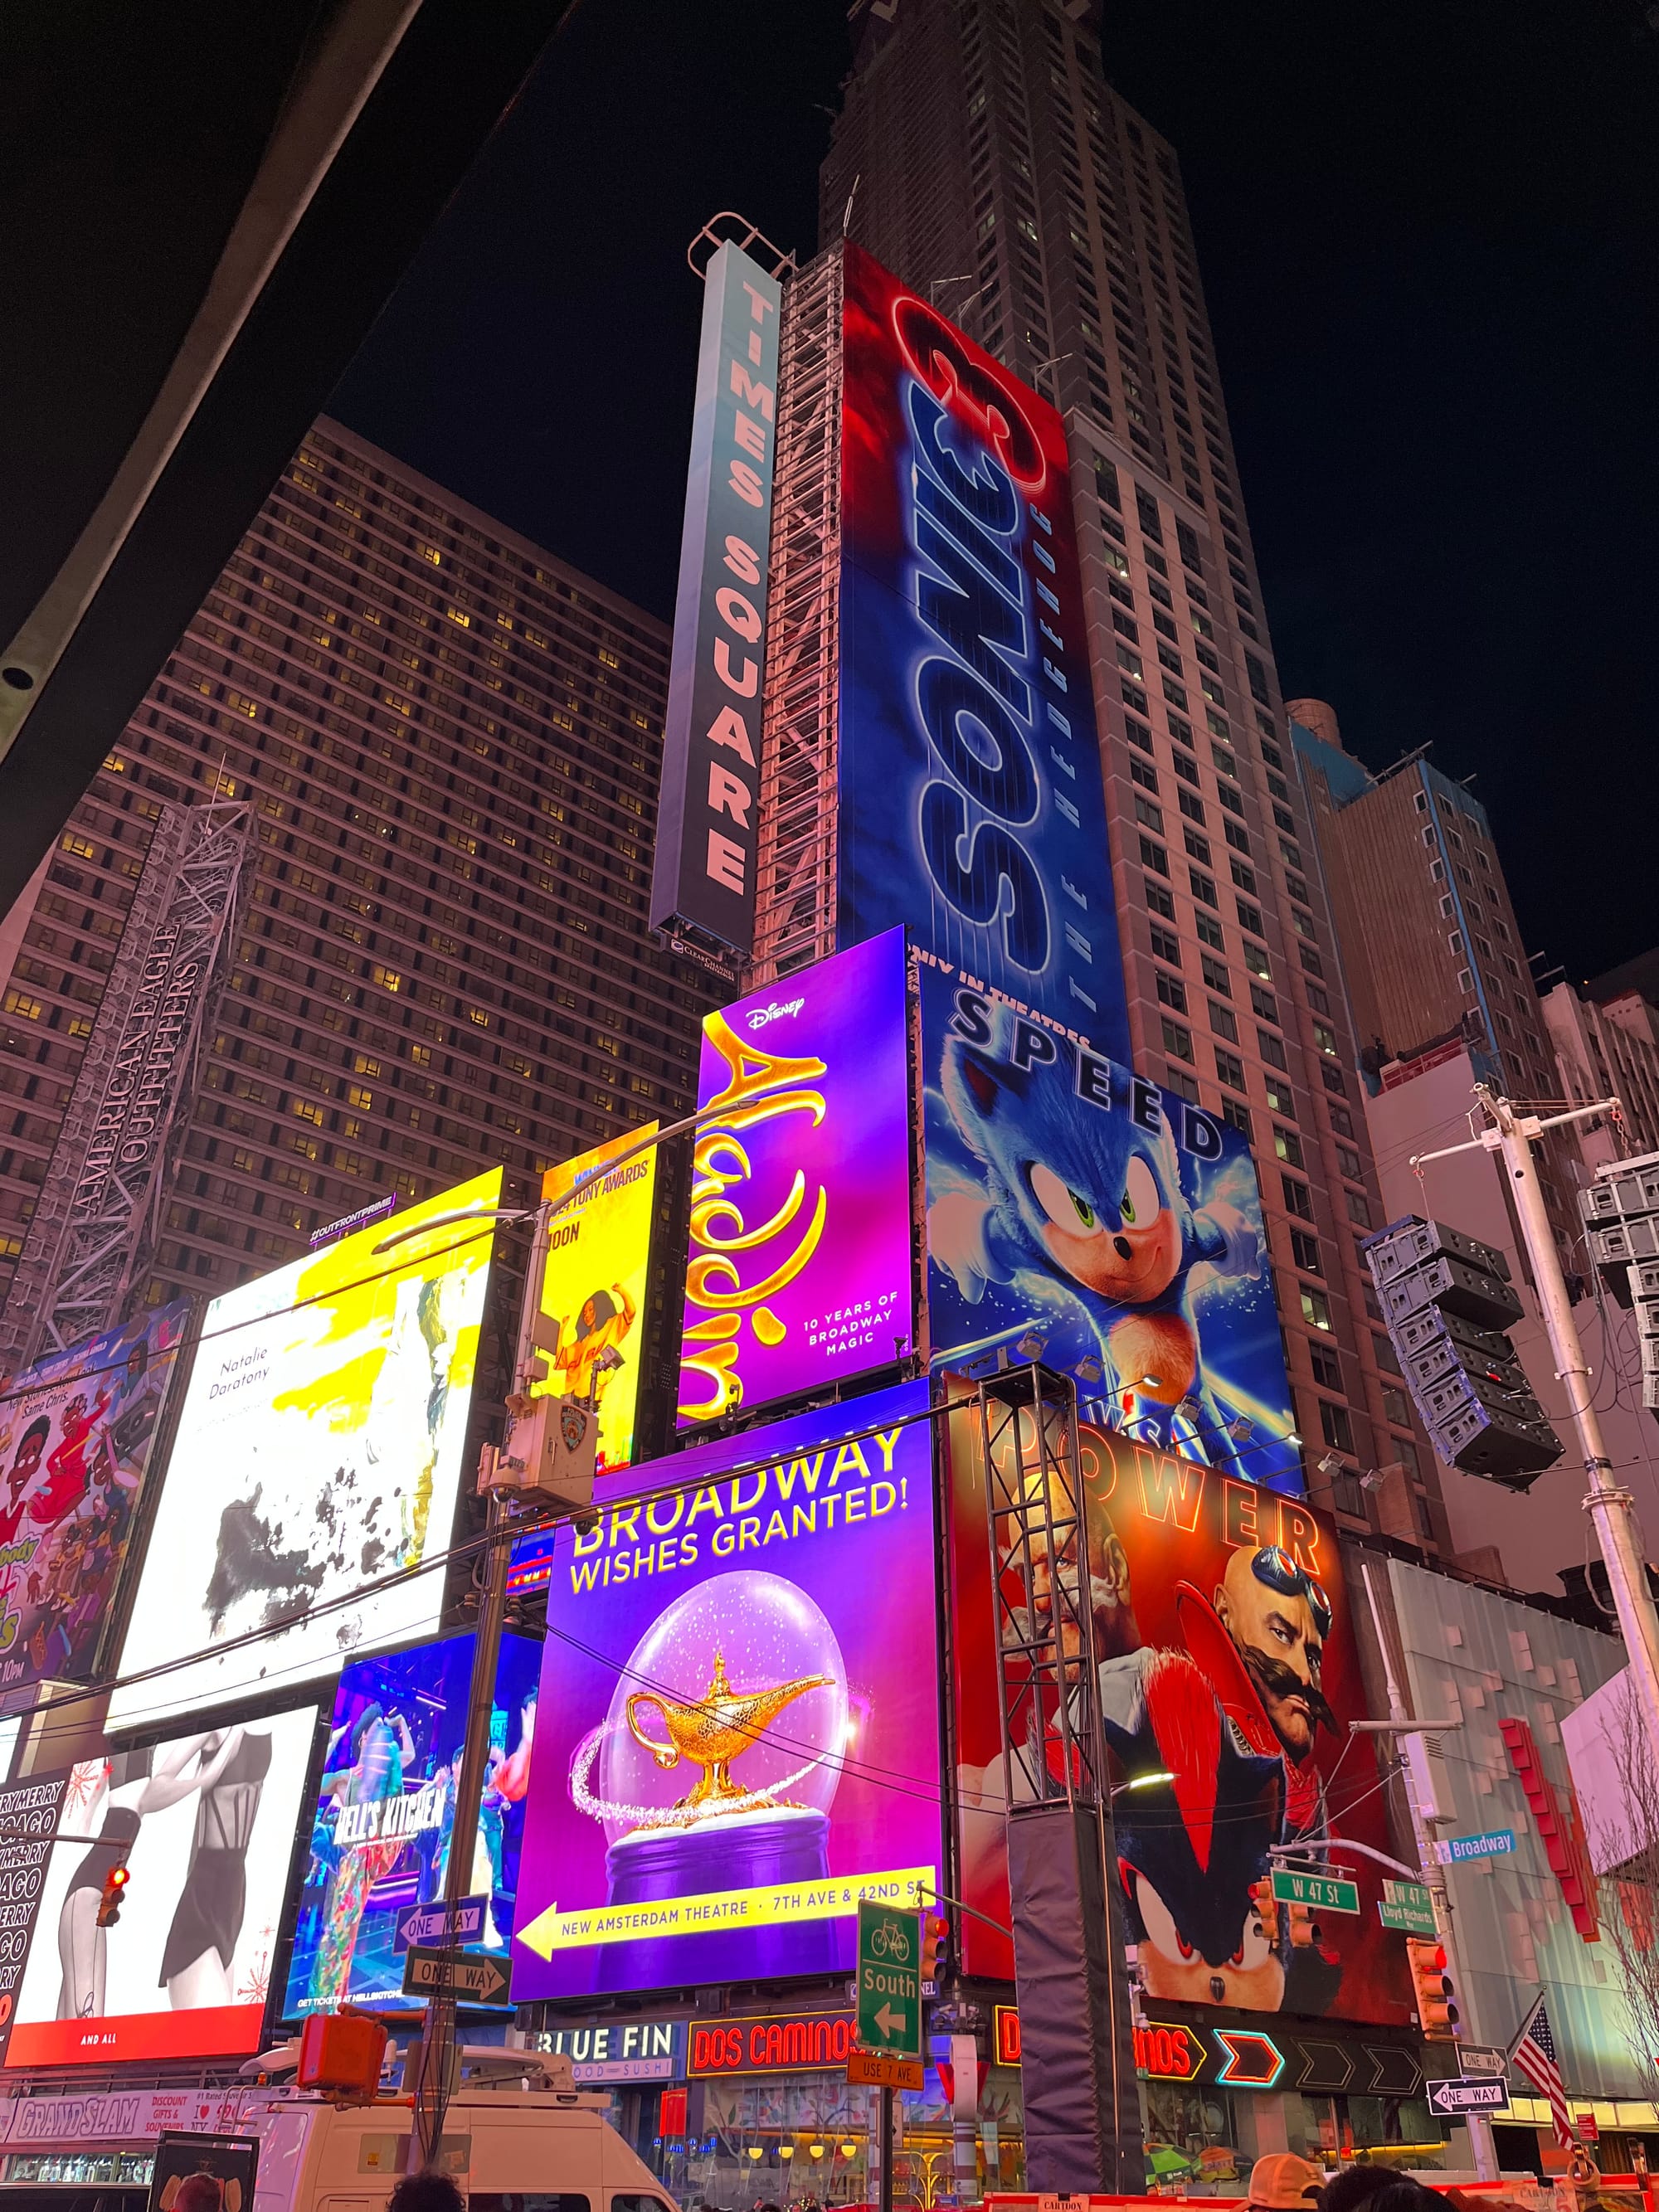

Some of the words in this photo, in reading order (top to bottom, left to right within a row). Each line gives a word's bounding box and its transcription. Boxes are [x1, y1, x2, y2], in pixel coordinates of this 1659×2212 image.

[726, 280, 775, 510] TIMES
[889, 294, 1049, 496] 3
[902, 372, 1053, 979] SONIC
[1030, 500, 1080, 829] HEDGEHOG
[704, 533, 761, 897] SQUARE
[1068, 871, 1100, 1012] THE
[747, 997, 805, 1030] Disney
[946, 987, 1223, 1160] SPEED
[601, 1159, 650, 1195] AWARDS
[677, 1011, 828, 1420] Aladdin
[802, 1320, 815, 1332] 10
[824, 1304, 873, 1326] YEARS
[878, 1291, 898, 1307] OF
[809, 1309, 893, 1346] BROADWAY
[826, 1331, 874, 1356] MAGIC
[220, 1347, 267, 1377] Natalie
[22, 1402, 45, 1419] Same
[46, 1390, 69, 1410] Chris.
[573, 1415, 907, 1558] BROADWAY
[980, 1403, 1321, 1574] POWER
[571, 1533, 699, 1595] WISHES
[712, 1478, 908, 1557] GRANTED!
[333, 1801, 381, 1845] HELL'S
[381, 1787, 447, 1836] KITCHEN
[1452, 1835, 1511, 1857] Broadway
[1292, 1878, 1304, 1898] W
[1309, 1882, 1321, 1901] 47
[1326, 1884, 1340, 1904] St
[1395, 1884, 1405, 1903] W
[1409, 1888, 1419, 1905] 47
[561, 1920, 591, 1936] NEW
[596, 1908, 679, 1931] AMSTERDAM
[684, 1901, 749, 1923] THEATRE
[773, 1895, 801, 1910] 7TH
[806, 1889, 837, 1905] AVE
[842, 1889, 852, 1903] &
[858, 1882, 902, 1900] 42ND
[1383, 1904, 1403, 1922] Lloyd
[1403, 1908, 1433, 1924] Richards
[408, 1918, 433, 1937] ONE
[421, 1963, 452, 1983] ONE
[465, 1968, 496, 1989] WAY
[864, 1968, 916, 1999] South
[298, 2000, 312, 2008] GET
[313, 1996, 342, 2005] TICKETS
[80, 2035, 100, 2046] AND
[101, 2033, 116, 2044] ALL
[538, 2032, 610, 2060] BLUE
[623, 2024, 673, 2058] FIN
[694, 2028, 743, 2069] DOS
[573, 2065, 604, 2078] OOD
[624, 2062, 670, 2075] SUSHI
[863, 2062, 881, 2078] USE
[898, 2066, 912, 2082] AVE
[1466, 2054, 1481, 2067] ONE
[1486, 2057, 1500, 2069] WAY
[152, 2096, 187, 2106] DISCOUNT
[1441, 2090, 1463, 2103] ONE
[1472, 2088, 1496, 2102] WAY
[17, 2101, 84, 2138] GRAND
[80, 2097, 140, 2137] SLAM
[153, 2109, 172, 2119] GIFTS
[173, 2109, 179, 2118] &
[191, 2122, 208, 2132] NY
